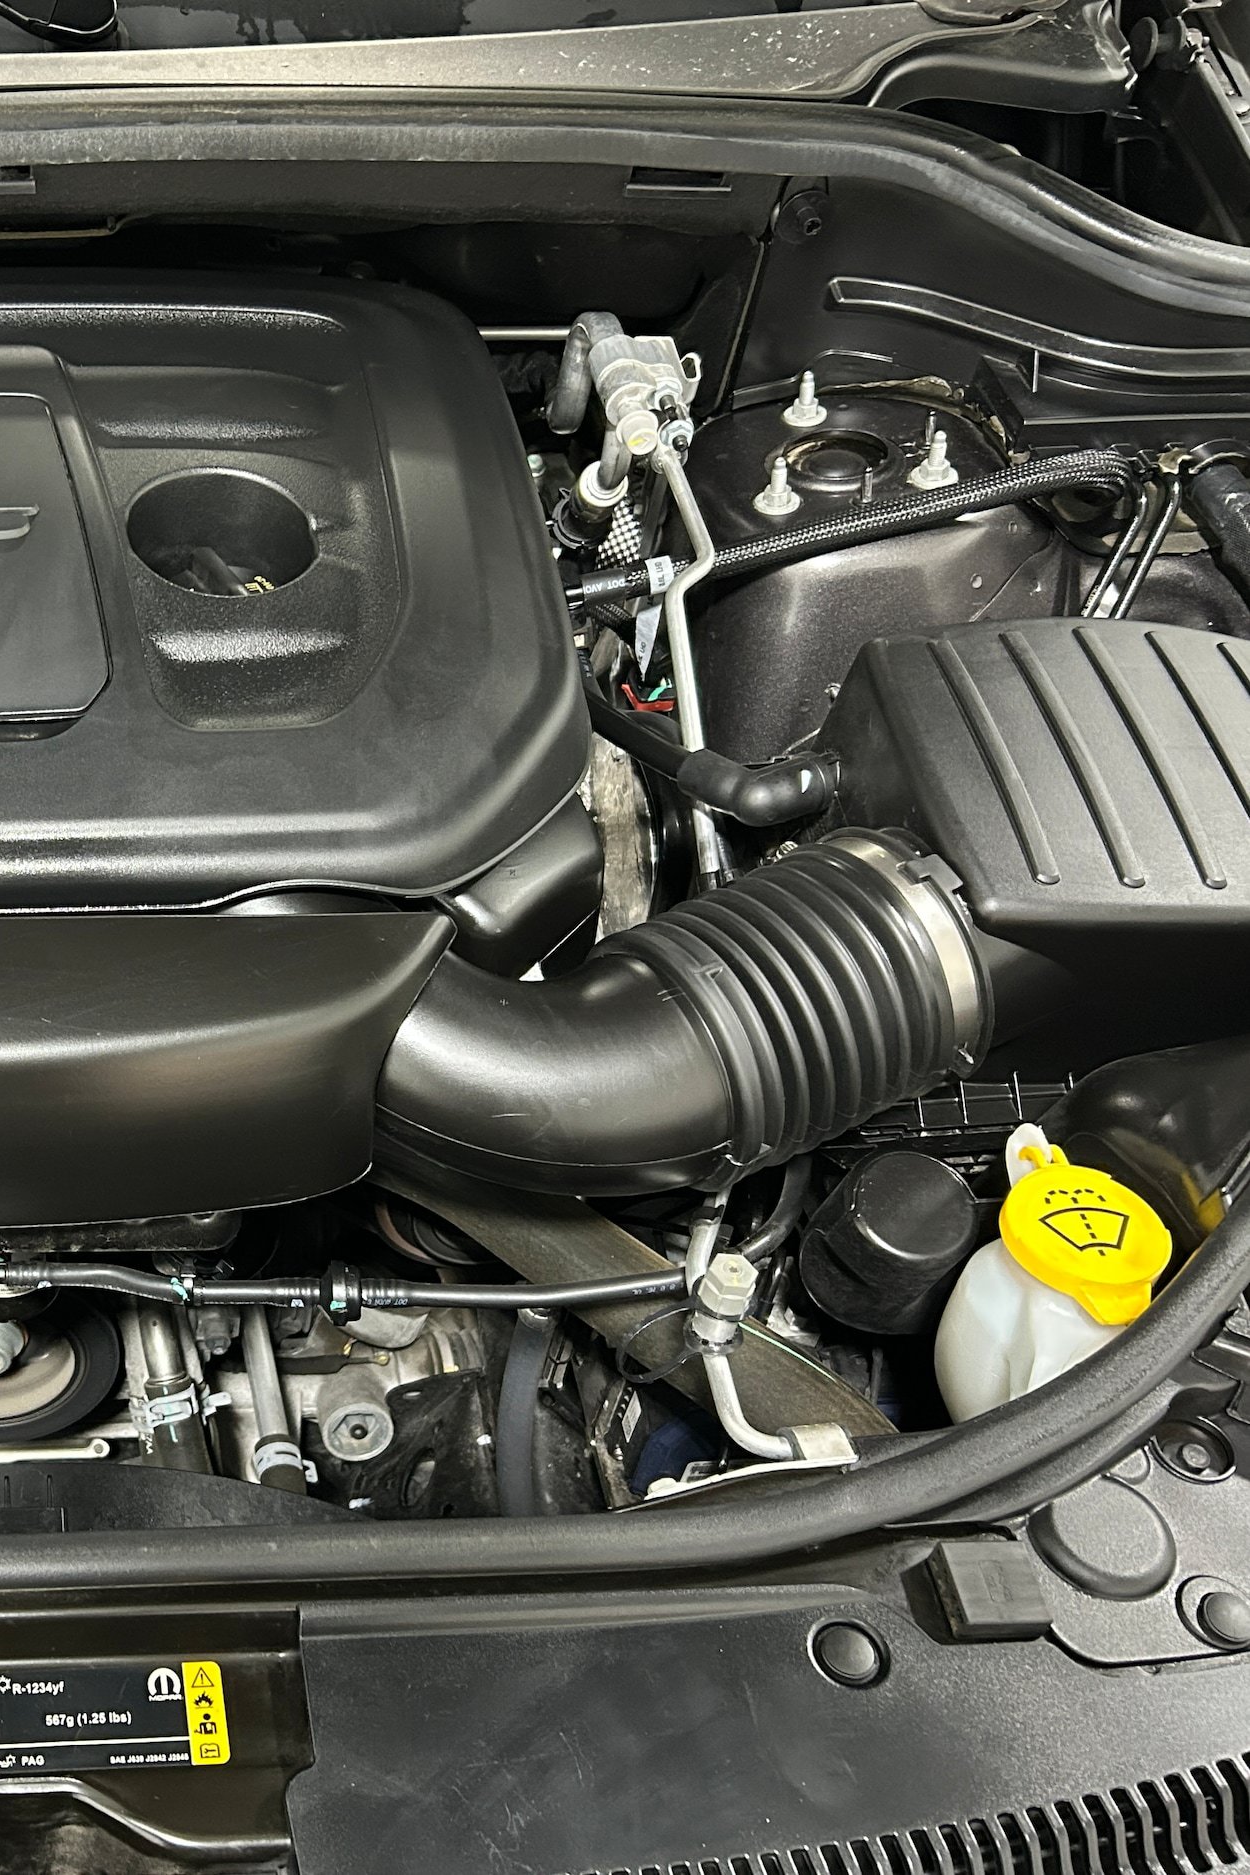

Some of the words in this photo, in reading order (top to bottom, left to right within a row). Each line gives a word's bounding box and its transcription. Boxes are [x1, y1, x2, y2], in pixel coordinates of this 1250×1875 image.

[607, 579, 626, 589] DOT
[12, 1681, 65, 1696] R-1234yf
[45, 1713, 75, 1728] 567g
[77, 1712, 106, 1727] (1.25
[109, 1711, 132, 1725] lbs)
[21, 1755, 45, 1767] PAG
